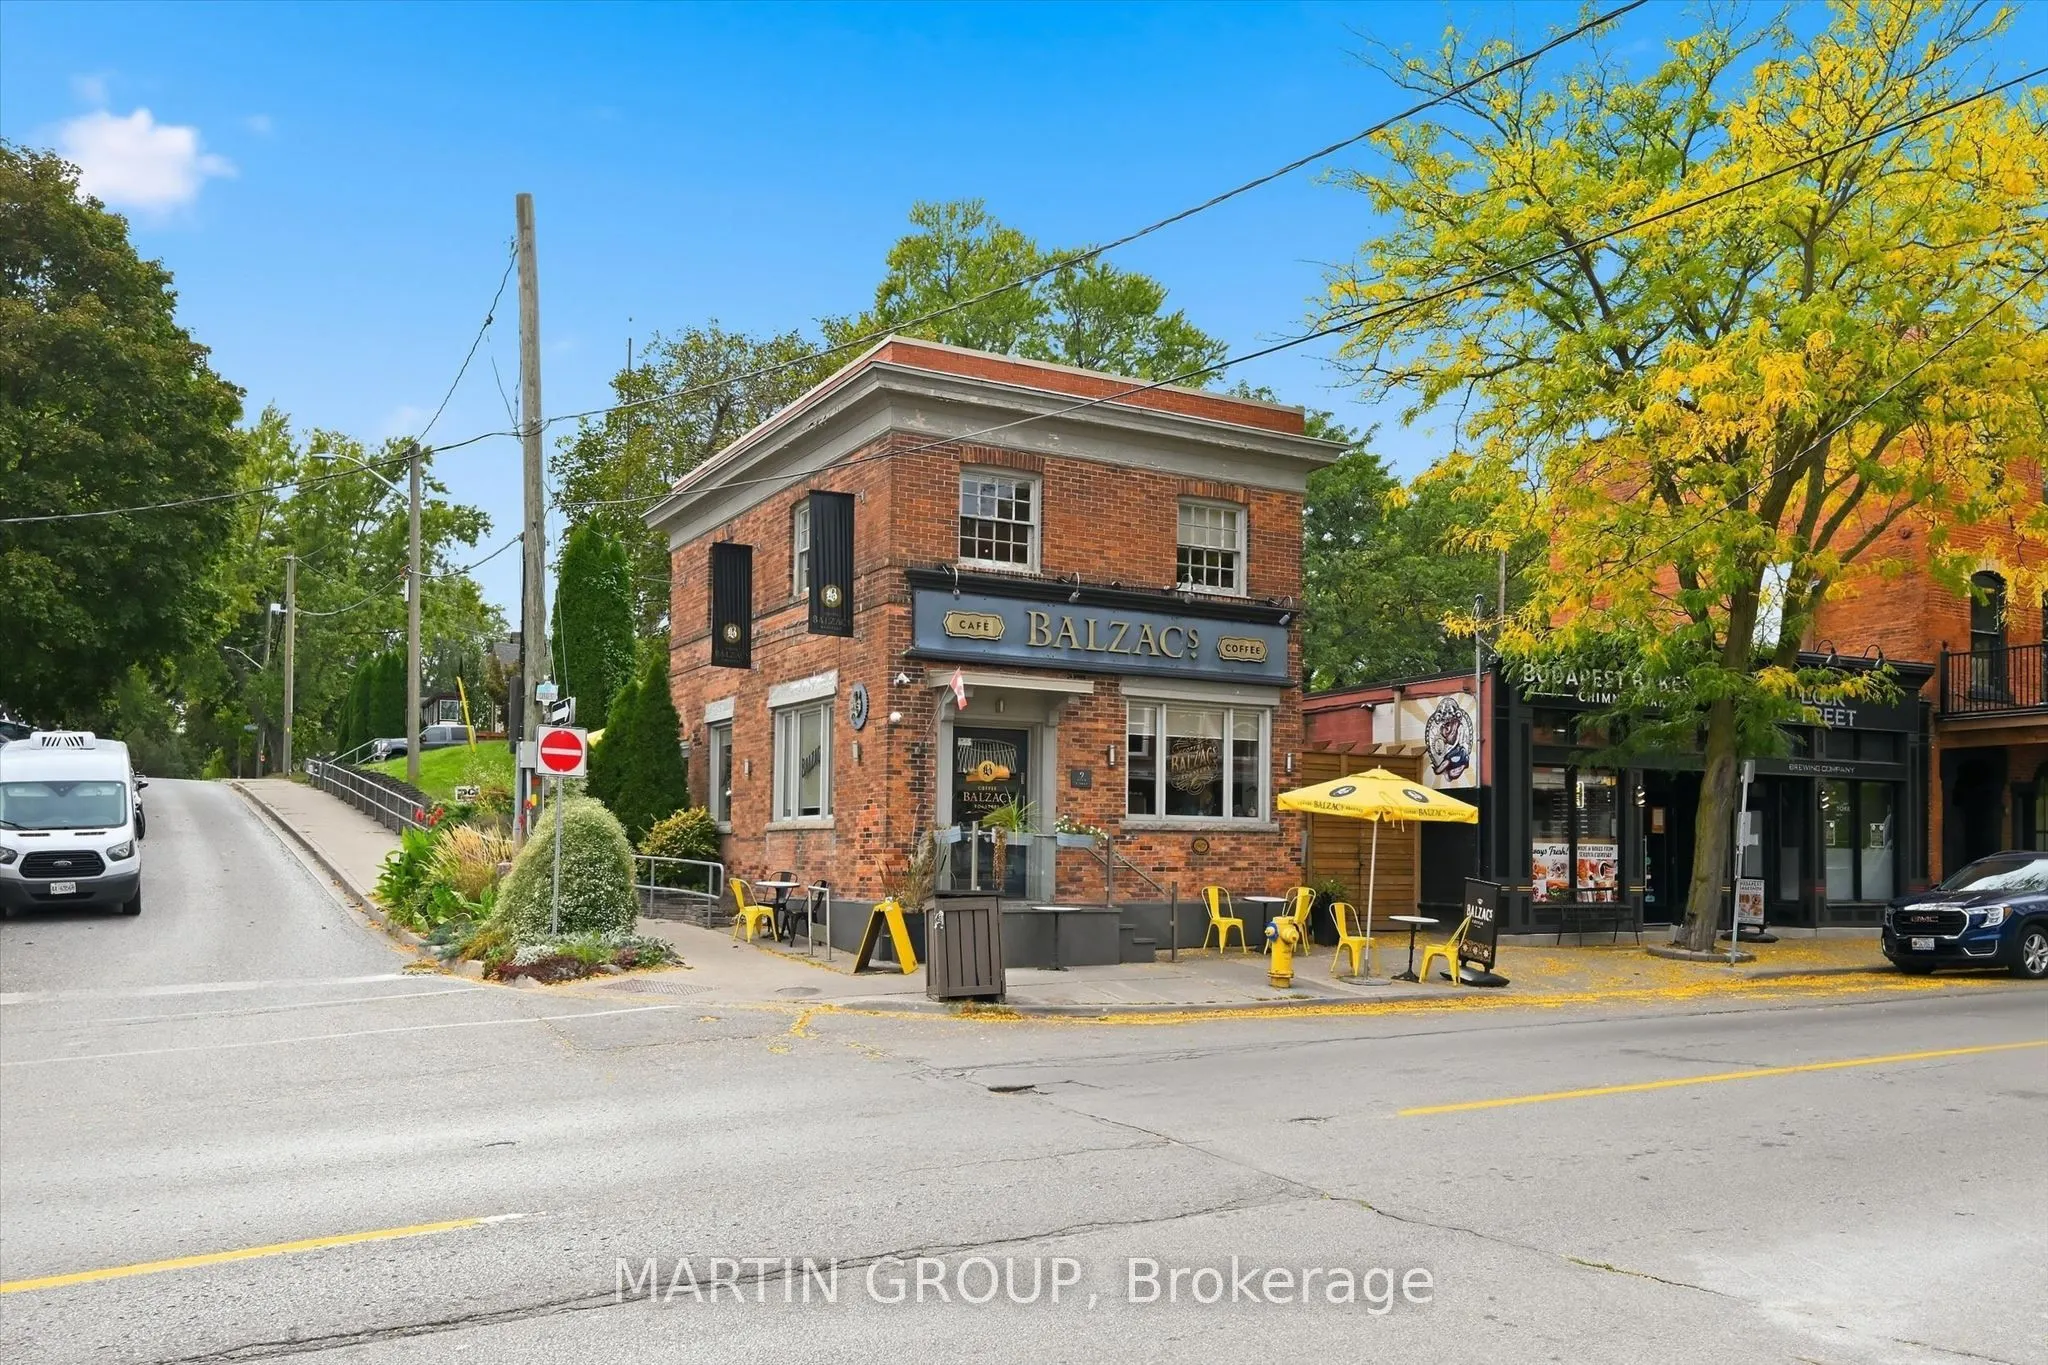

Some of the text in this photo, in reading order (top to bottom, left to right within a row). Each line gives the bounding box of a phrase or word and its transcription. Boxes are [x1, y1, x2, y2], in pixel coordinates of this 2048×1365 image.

[1225, 643, 1261, 655] COFFEE
[1787, 706, 1857, 727] TREET
[1549, 845, 1569, 857] Fresh!
